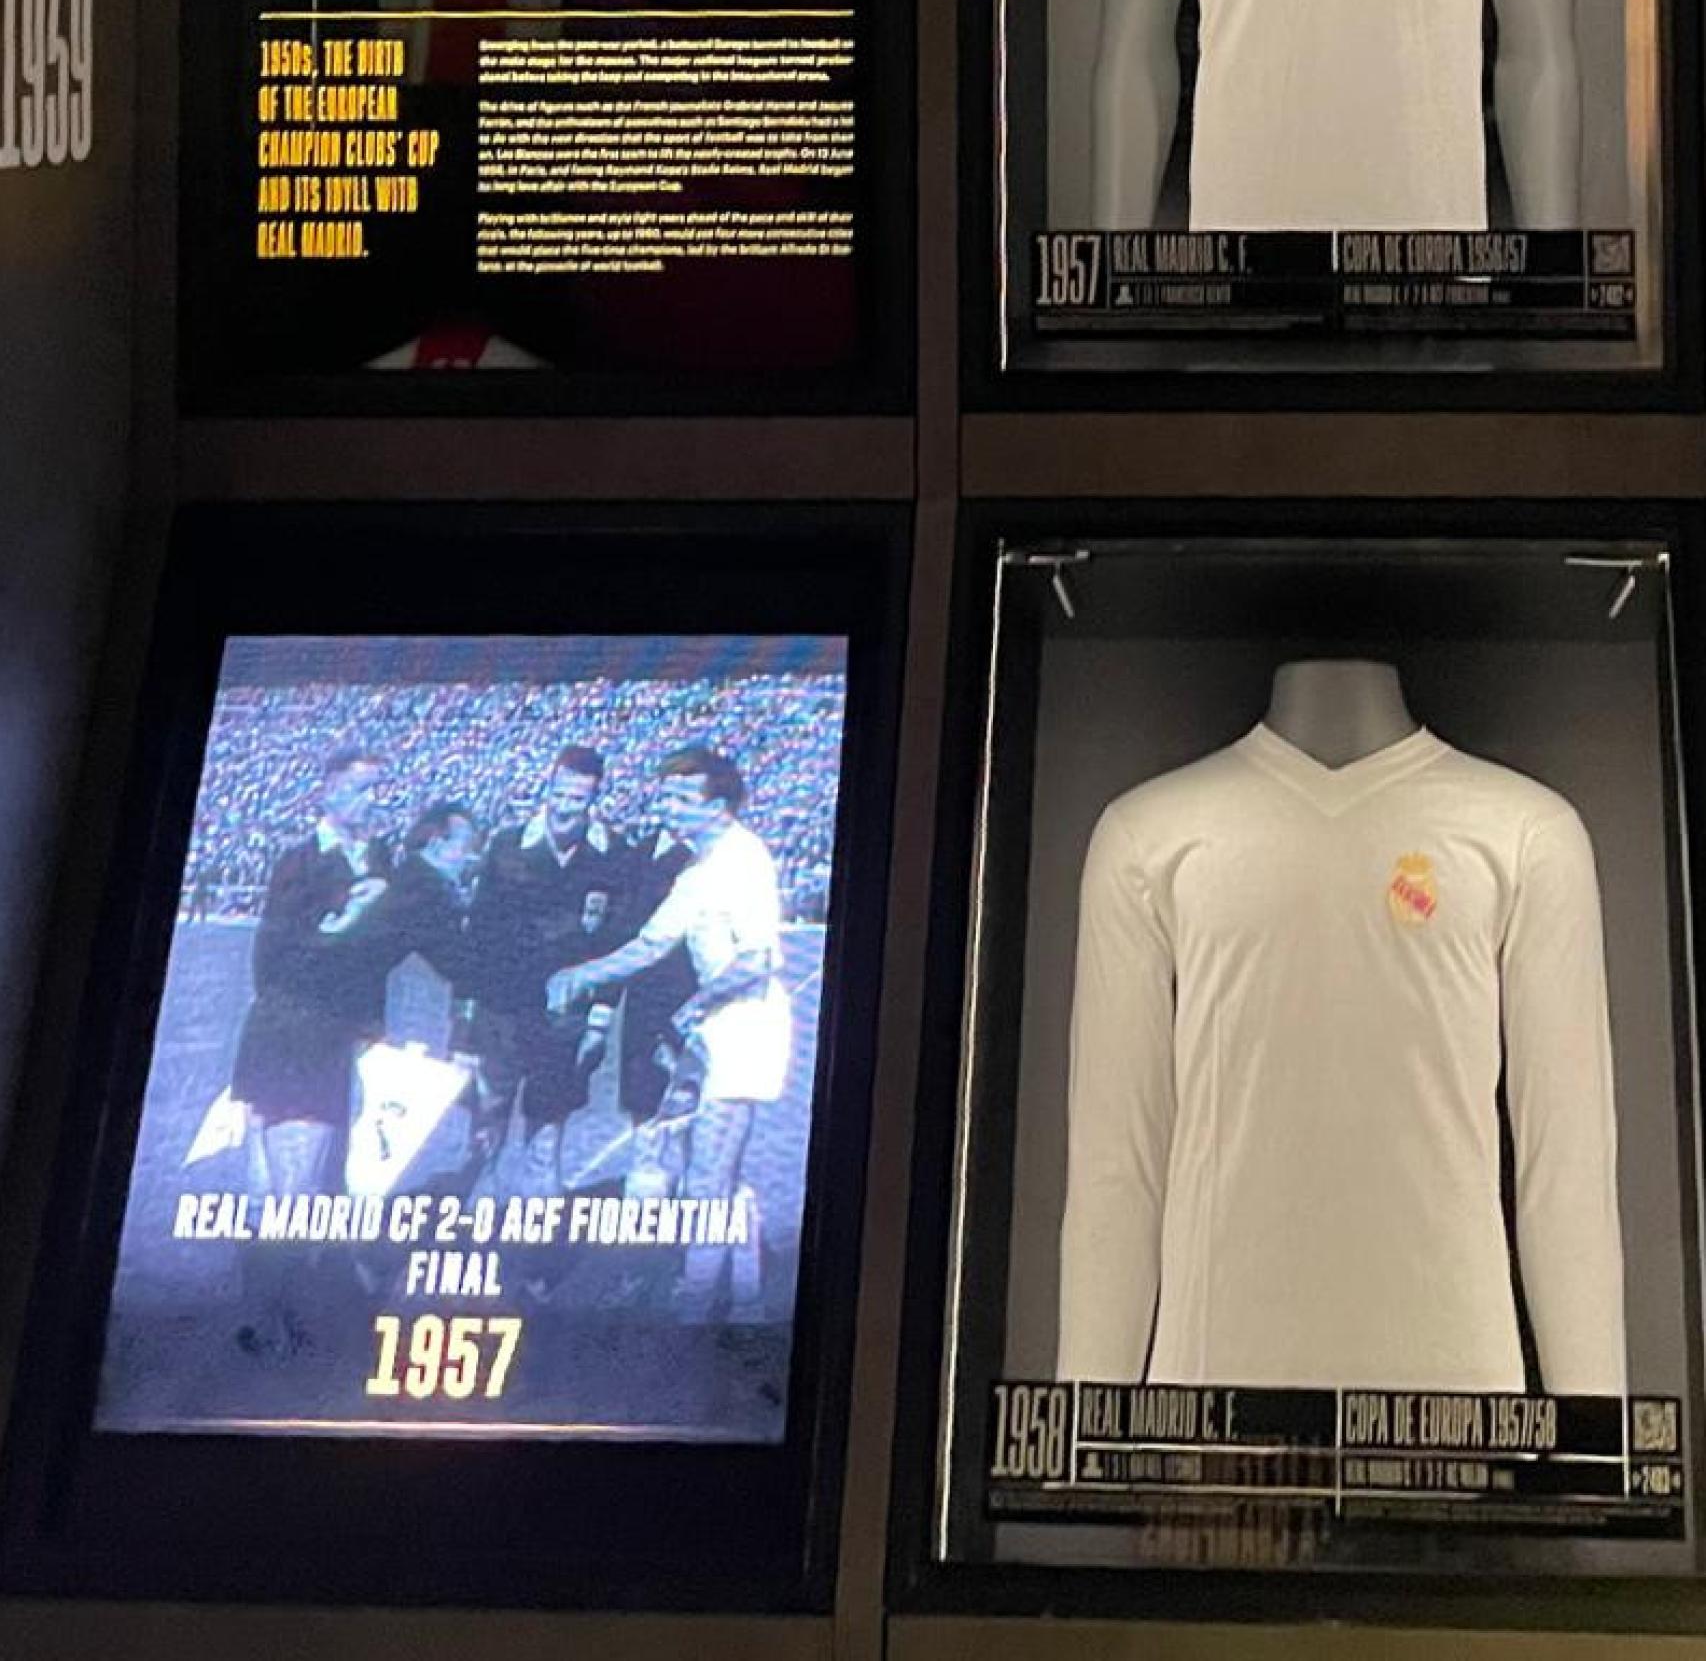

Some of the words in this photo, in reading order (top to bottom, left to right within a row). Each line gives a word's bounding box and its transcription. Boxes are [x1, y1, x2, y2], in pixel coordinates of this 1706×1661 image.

[323, 40, 353, 76] THE
[258, 86, 279, 122] OF
[284, 86, 313, 121] THE
[318, 86, 397, 121] EUROPEAN
[258, 131, 341, 167] CHAMPION
[408, 130, 440, 167] CUP
[294, 176, 321, 213] ITS
[257, 221, 297, 258] REAL
[1035, 234, 1101, 305] 1957
[172, 1193, 252, 1239] REAL
[258, 1194, 384, 1241] MADRID
[389, 1195, 431, 1242] CF
[435, 1196, 496, 1243] 2-0
[501, 1196, 565, 1244] ACF
[568, 1196, 749, 1244] FIORENTINA
[406, 1250, 502, 1295] FINAL
[365, 1314, 522, 1399] 1957
[989, 1385, 1065, 1479] 1958
[1081, 1388, 1123, 1438] REAL
[1129, 1389, 1197, 1438] MADRID
[1346, 1394, 1388, 1445] COPA
[1394, 1395, 1416, 1446] DE
[1420, 1396, 1483, 1447] EUROPA
